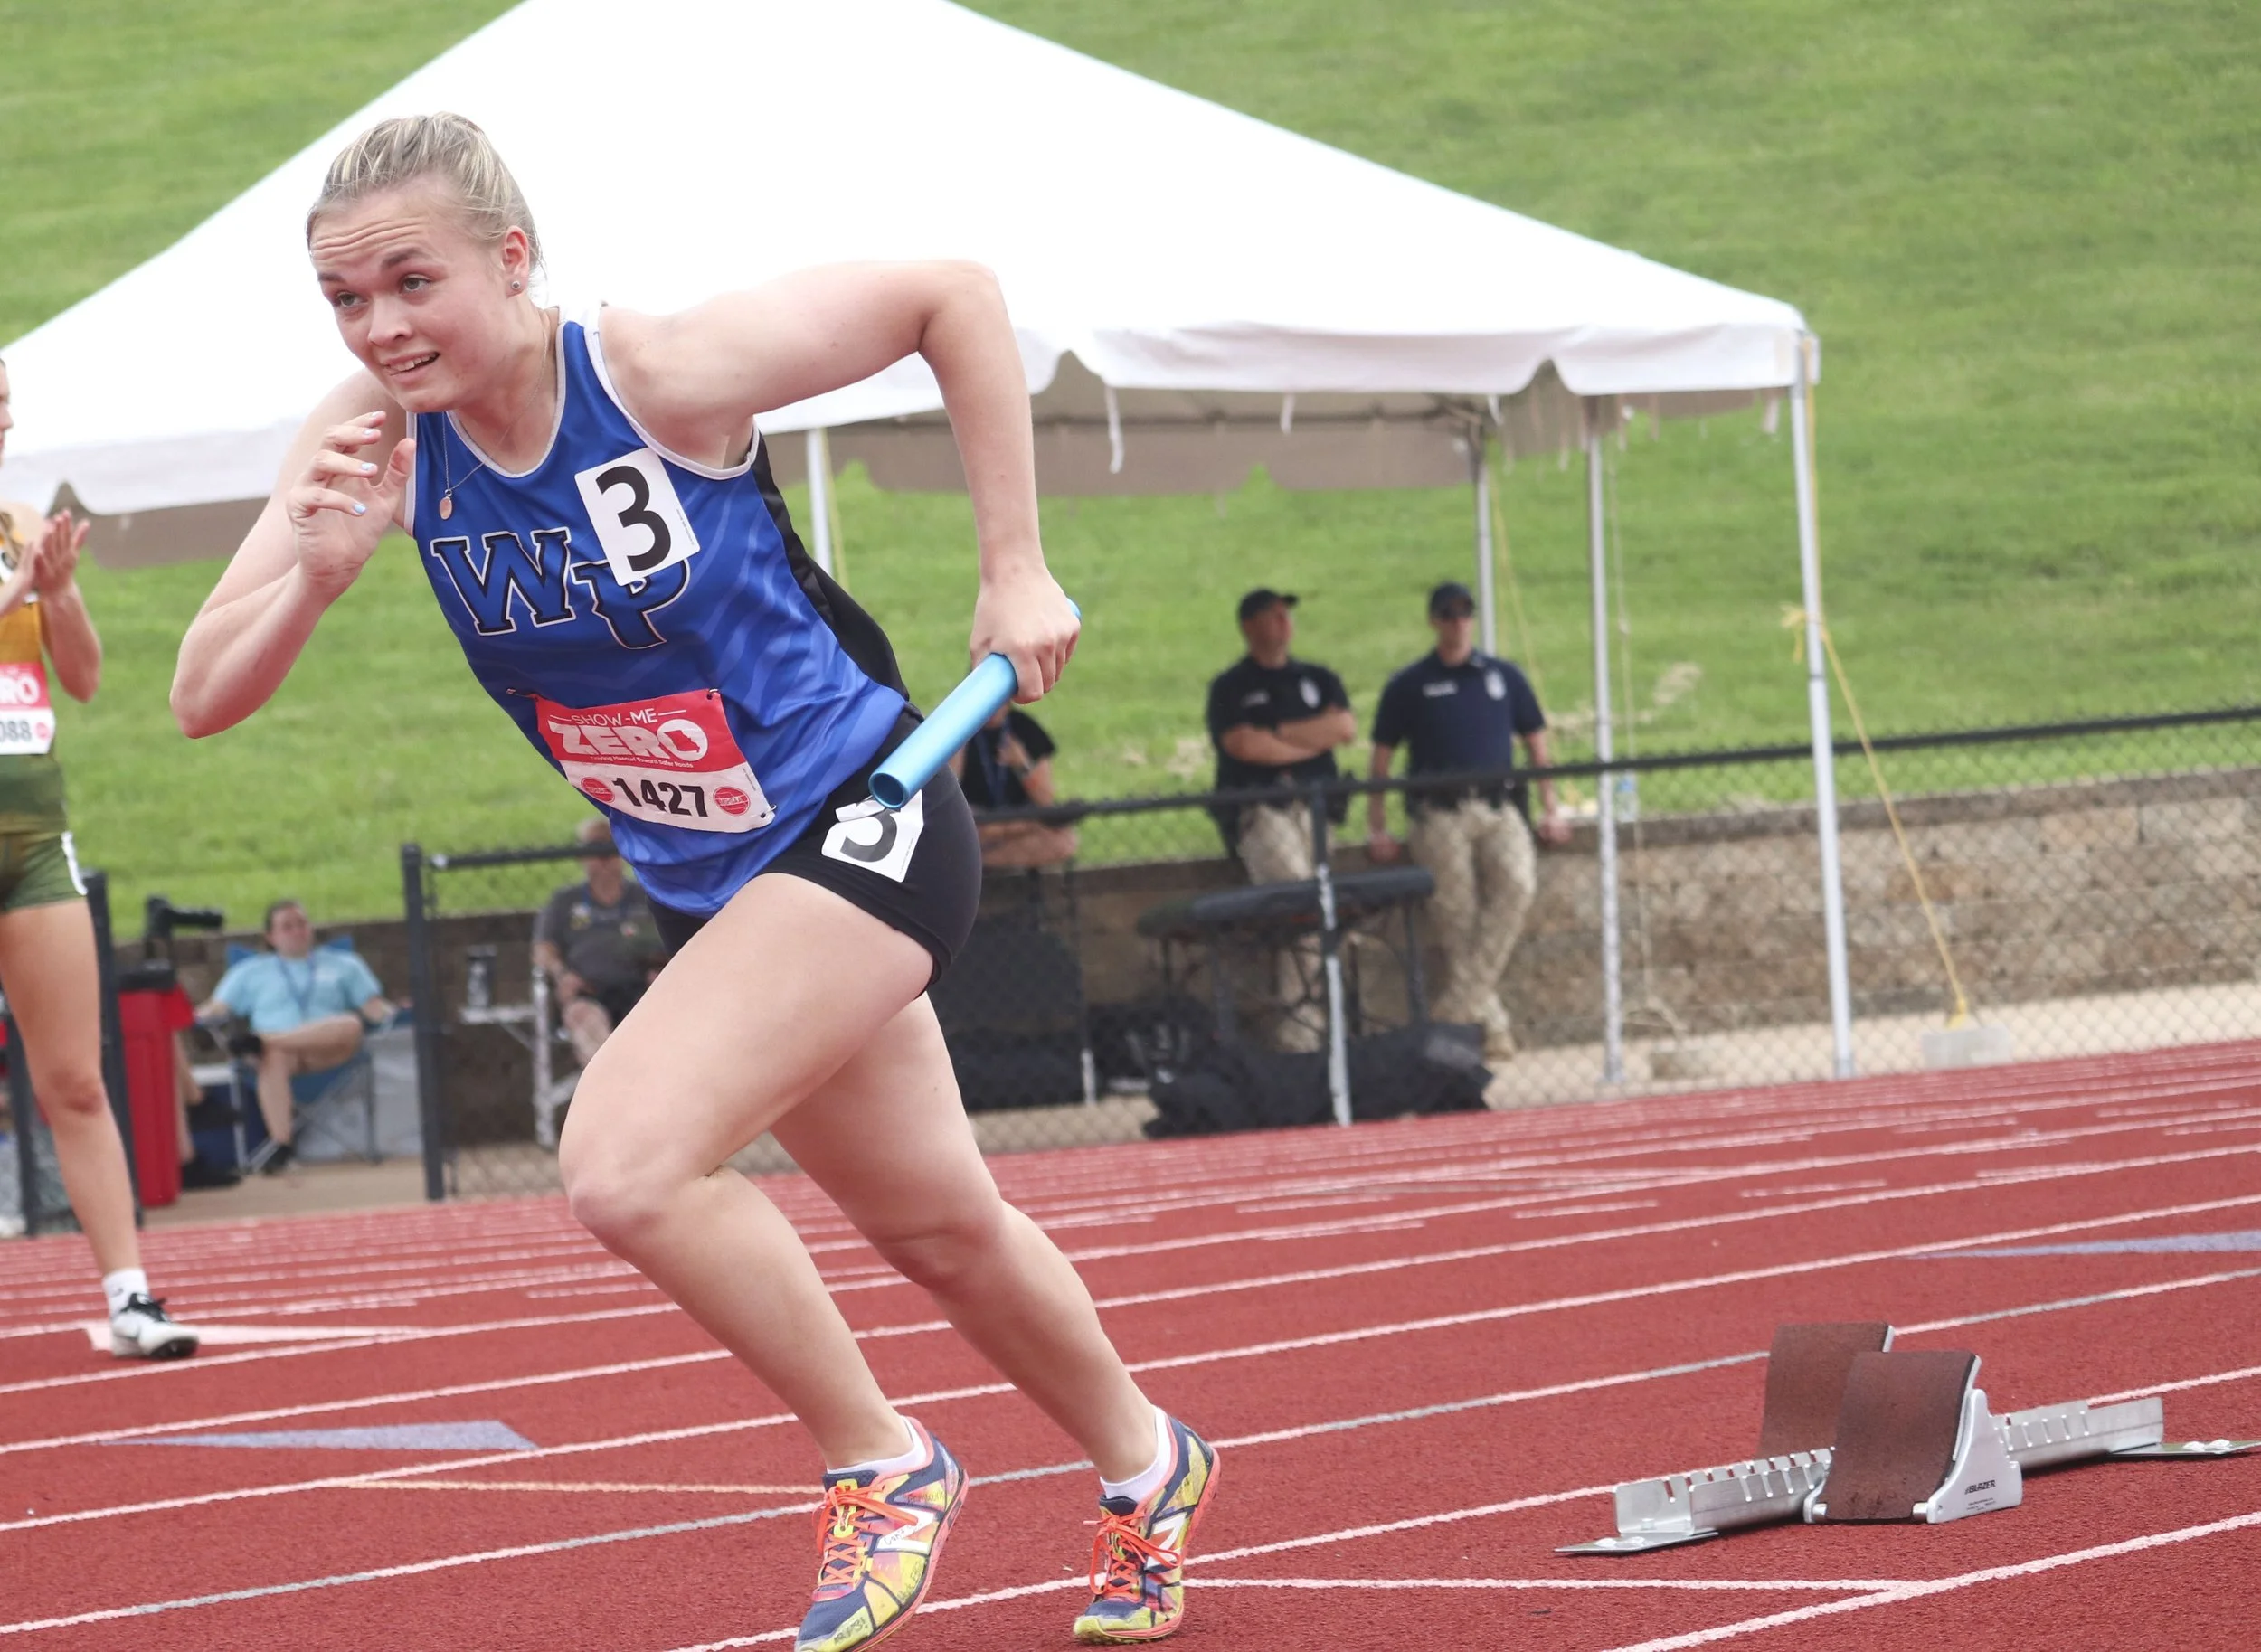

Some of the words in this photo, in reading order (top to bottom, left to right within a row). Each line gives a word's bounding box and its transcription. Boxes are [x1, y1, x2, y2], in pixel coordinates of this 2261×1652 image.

[595, 465, 672, 572] 3
[548, 719, 708, 761] ZERO
[612, 777, 708, 817] 1427
